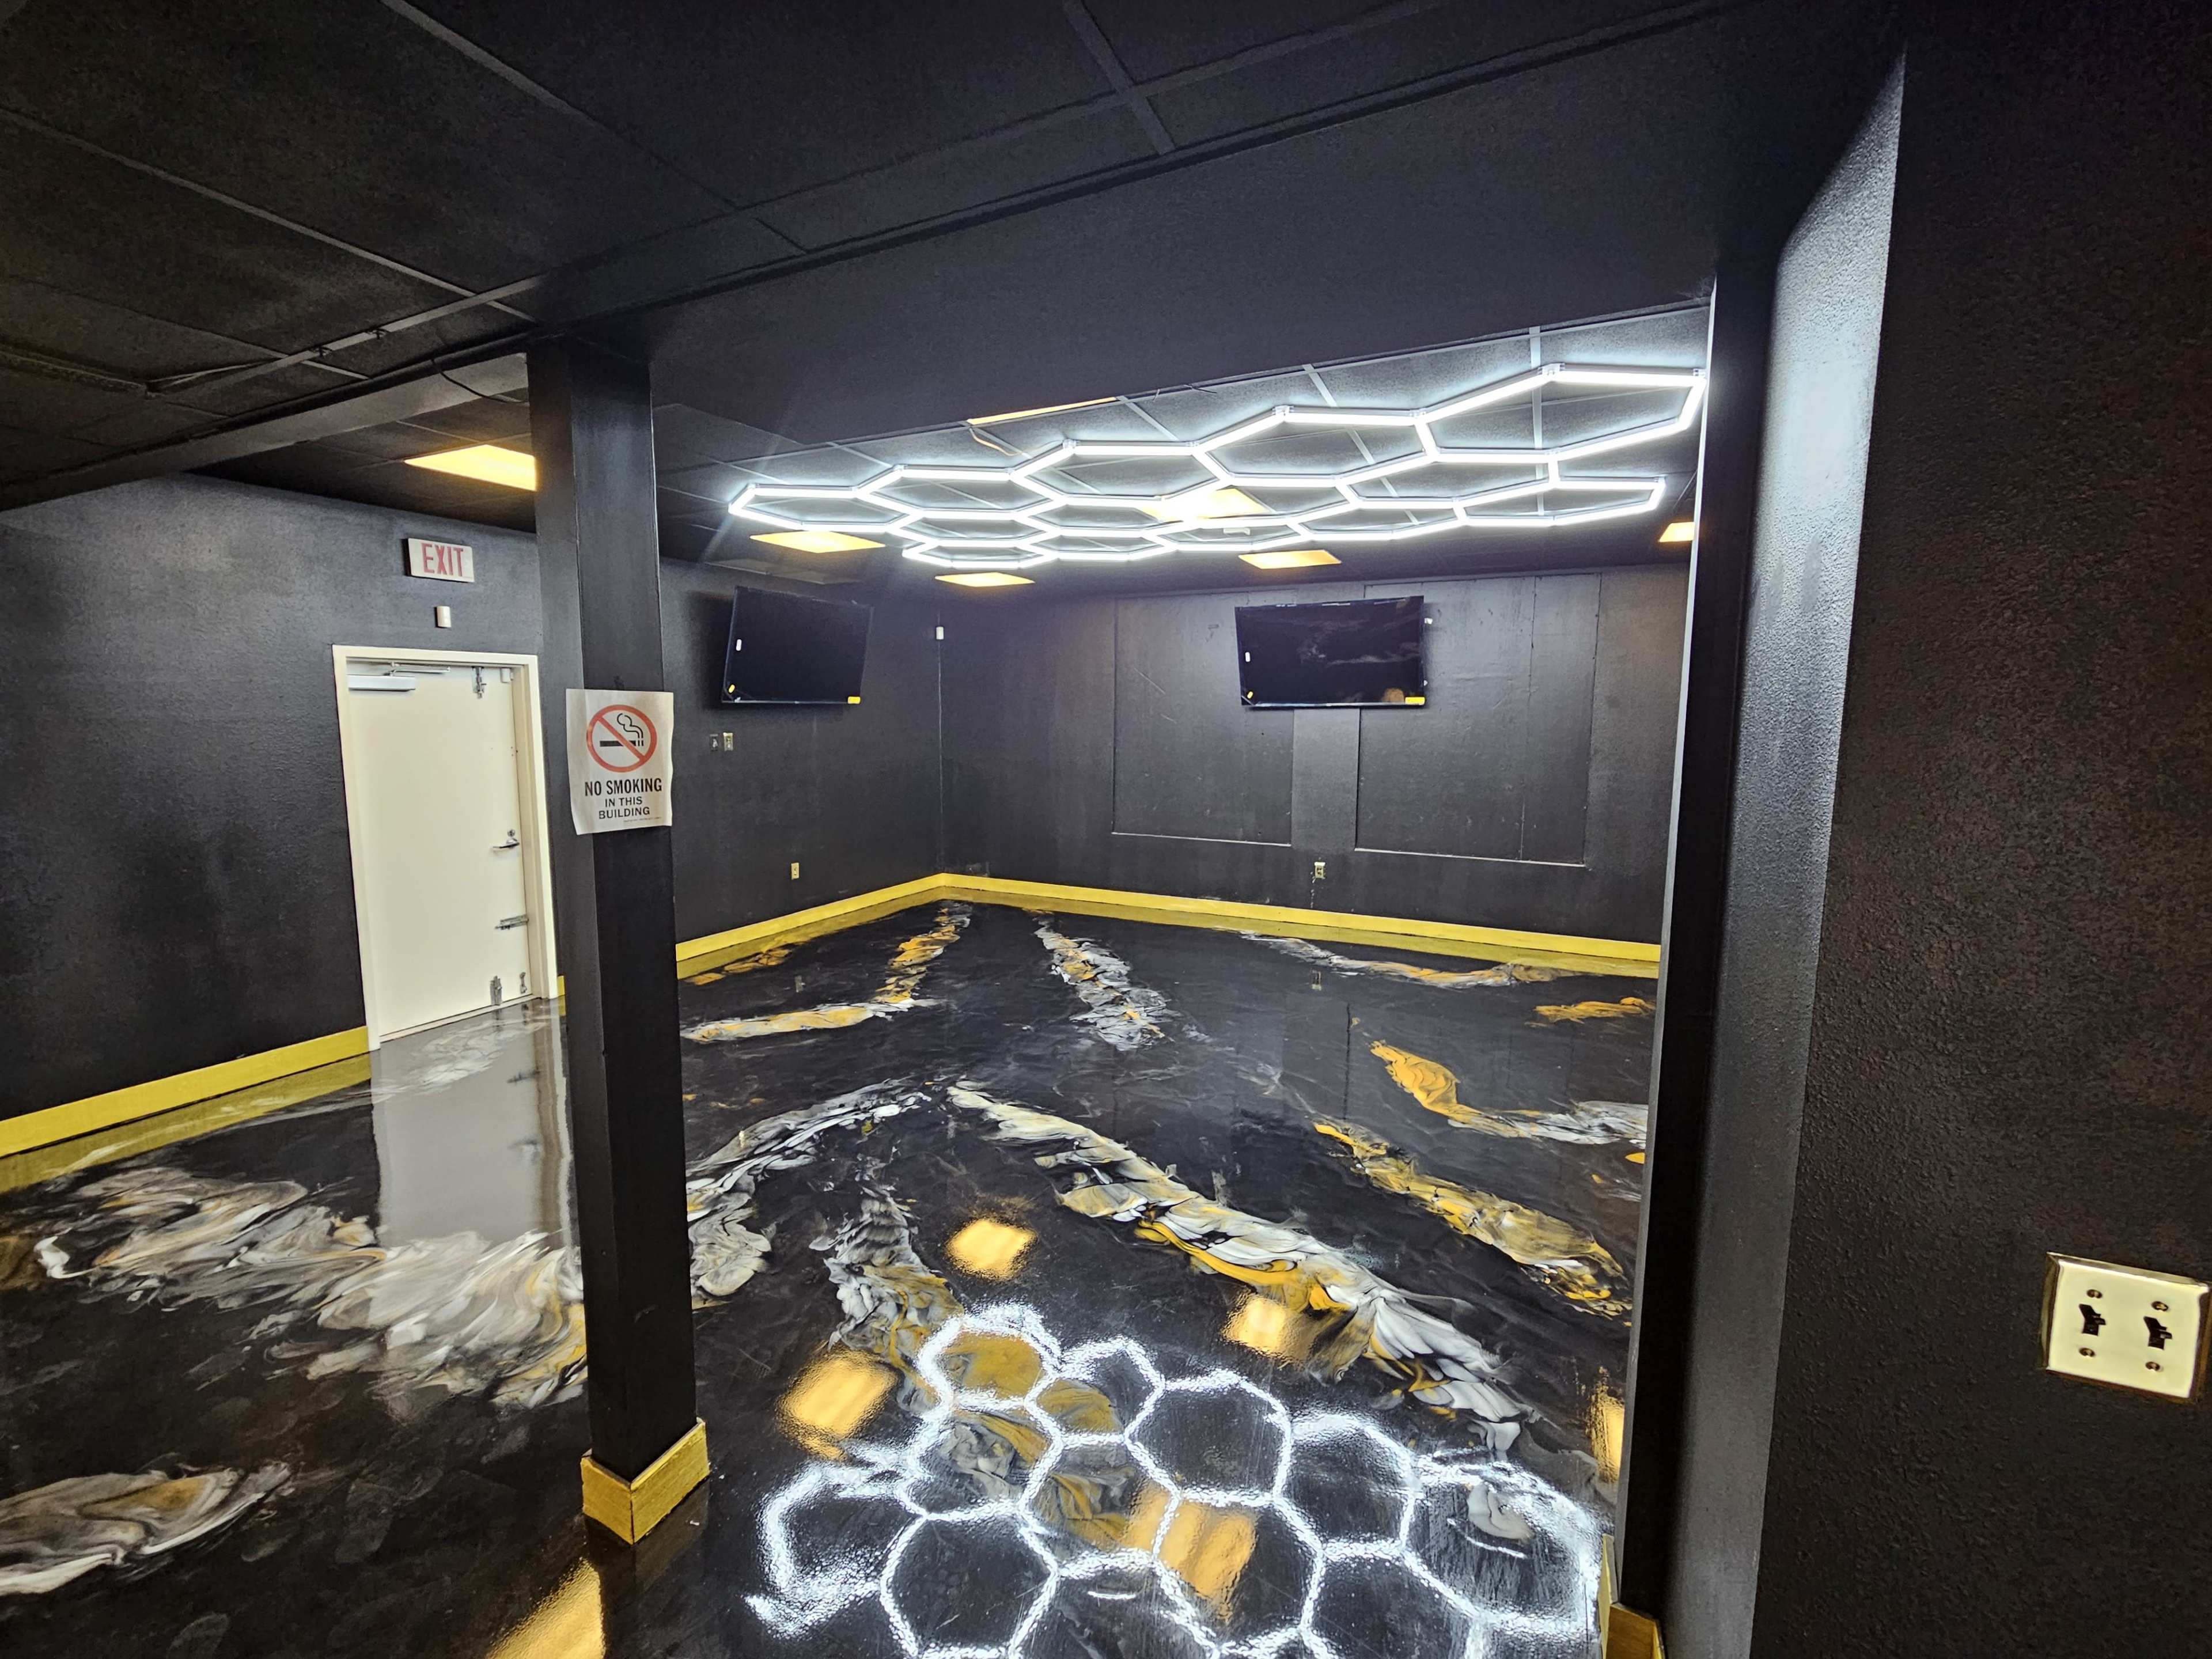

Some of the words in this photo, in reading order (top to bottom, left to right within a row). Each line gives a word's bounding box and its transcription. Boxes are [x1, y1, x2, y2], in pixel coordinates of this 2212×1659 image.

[421, 543, 464, 577] EXIT
[585, 781, 602, 796] NO
[607, 778, 662, 795] SMOKING
[605, 798, 615, 807] IN
[619, 797, 642, 806] THIS
[599, 807, 650, 819] BUILDING
